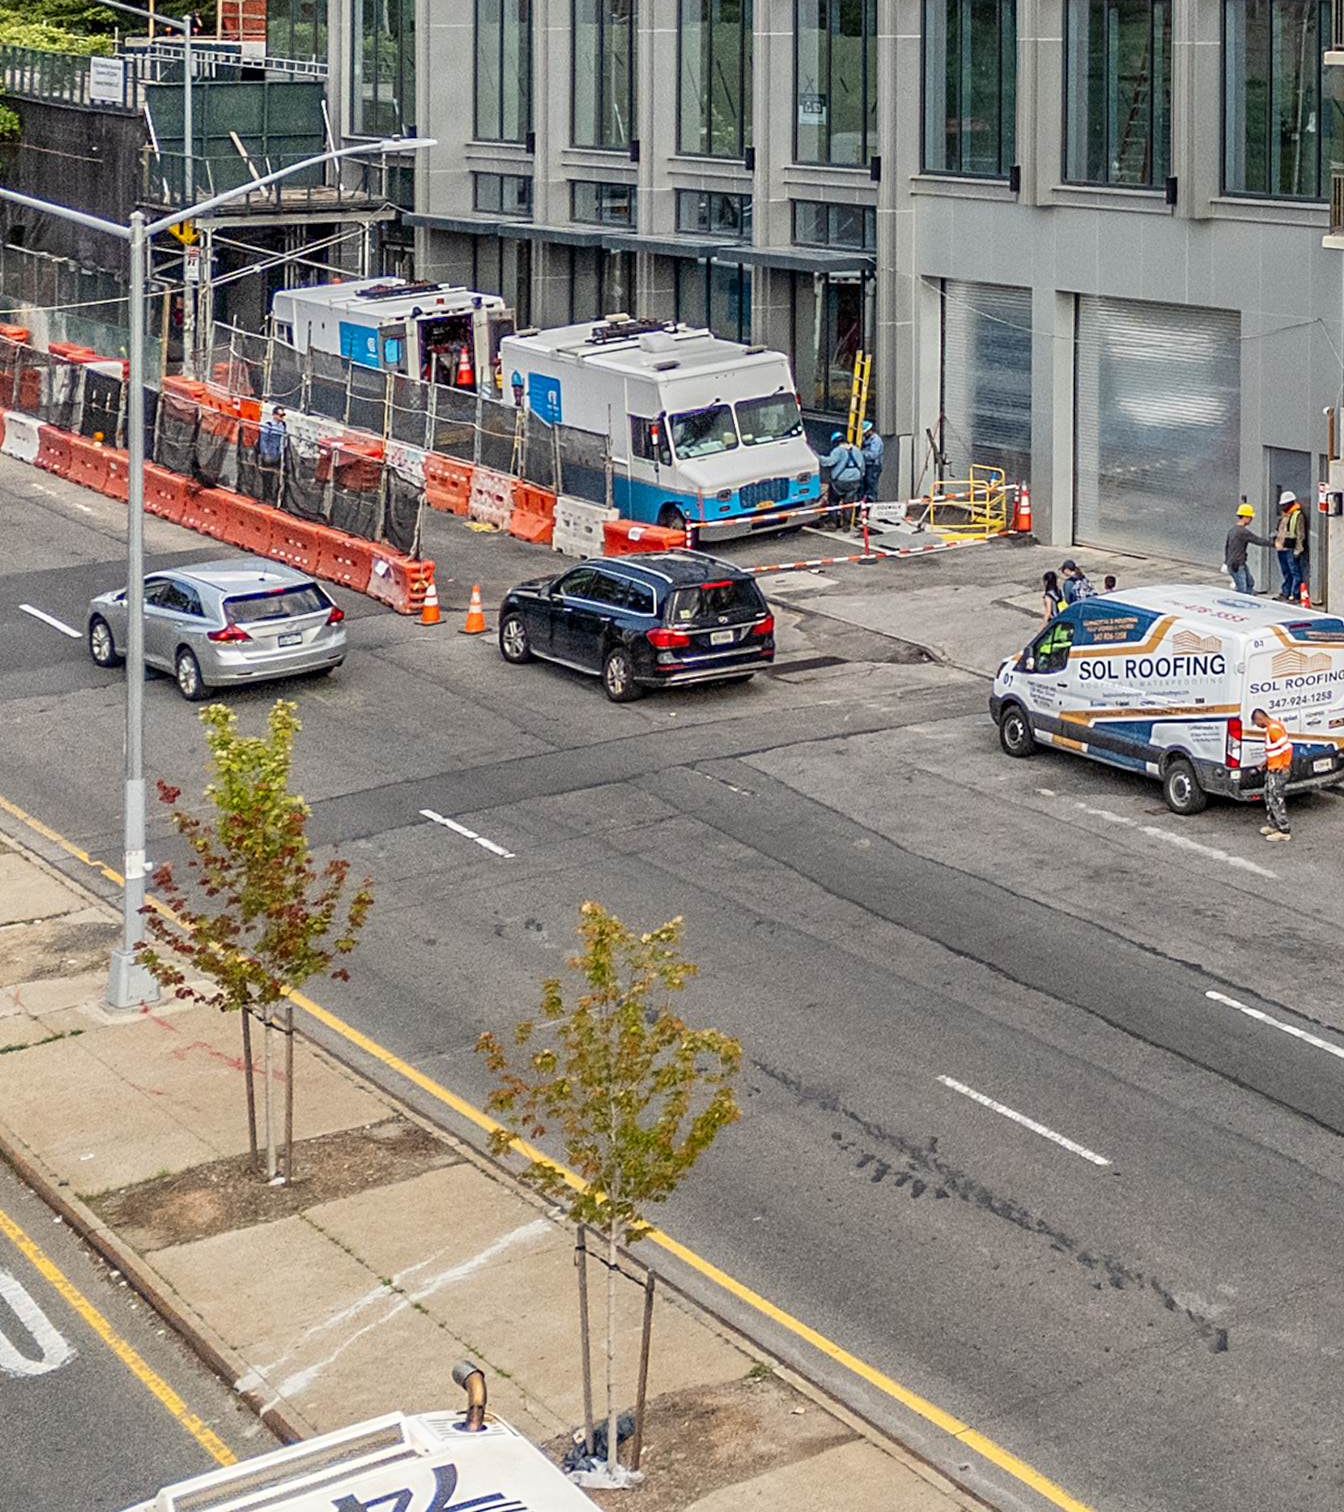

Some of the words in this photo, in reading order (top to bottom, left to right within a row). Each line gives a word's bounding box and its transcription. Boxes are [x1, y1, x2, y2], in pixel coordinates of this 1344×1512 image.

[1078, 660, 1119, 681] SOL
[1125, 654, 1226, 680] ROOFING
[1250, 682, 1280, 694] SOL
[1269, 690, 1333, 709] 347-924-1258
